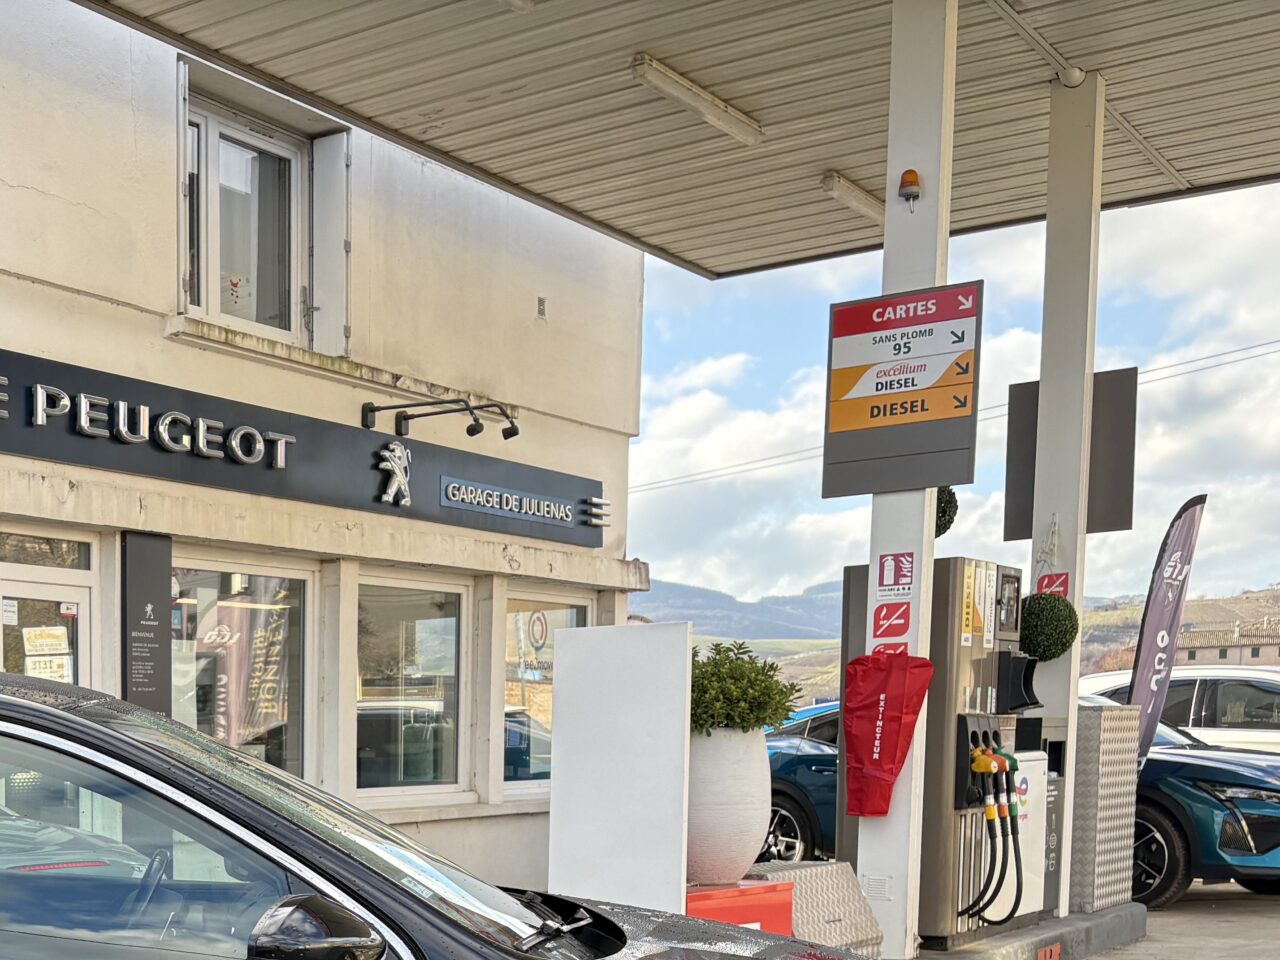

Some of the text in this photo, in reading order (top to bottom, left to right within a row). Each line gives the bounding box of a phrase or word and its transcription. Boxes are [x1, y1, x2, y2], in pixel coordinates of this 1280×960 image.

[872, 299, 937, 322] CARTES
[872, 328, 934, 345] SANS PLOMB
[892, 341, 912, 356] 95
[876, 363, 927, 379] excellium
[875, 377, 918, 392] DIESEL
[870, 399, 929, 418] DIESEL
[31, 383, 297, 469] PEUGEOT
[446, 483, 572, 521] GARAGE DE JULIENAS
[872, 693, 886, 760] EXTINCTEUR
